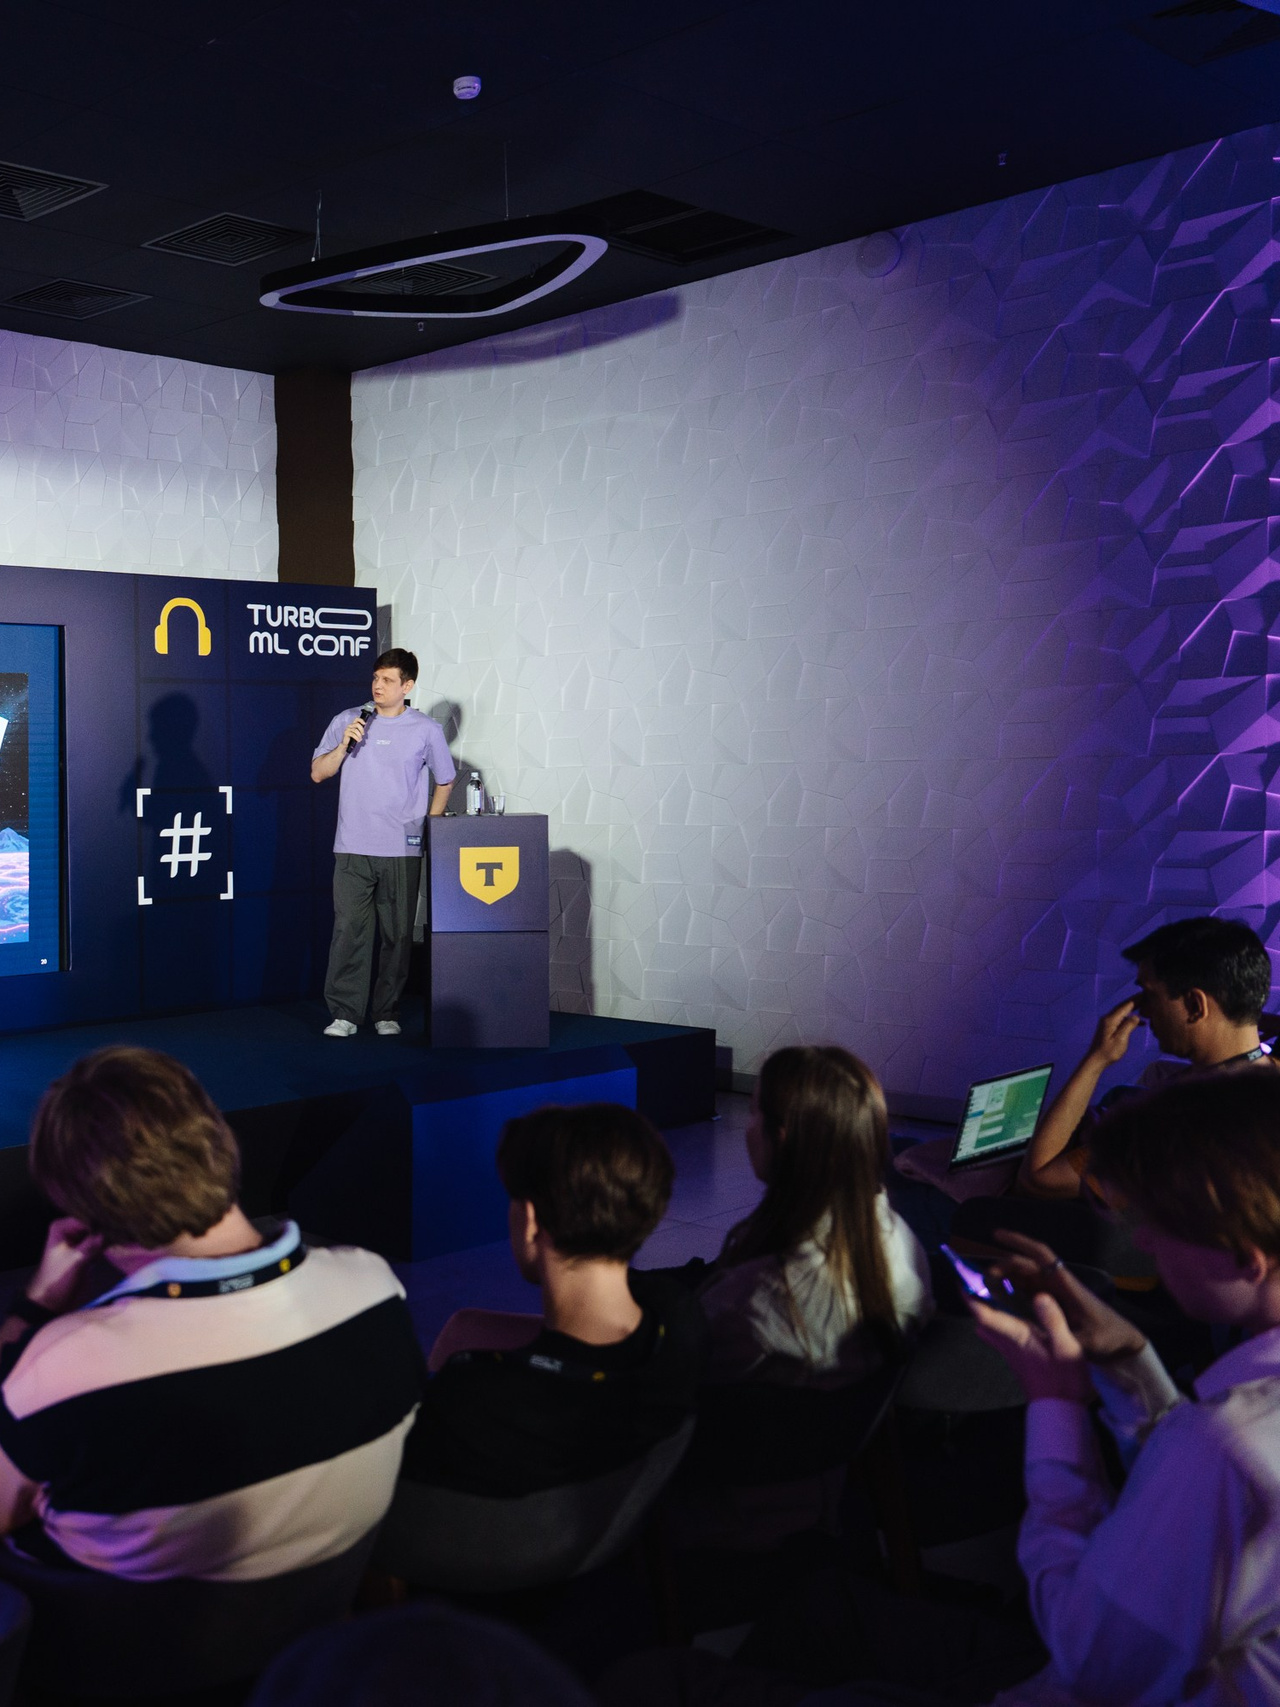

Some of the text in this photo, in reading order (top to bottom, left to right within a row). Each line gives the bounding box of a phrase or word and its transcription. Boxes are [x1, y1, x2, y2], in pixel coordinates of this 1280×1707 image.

[246, 603, 372, 631] TURBO
[249, 631, 371, 657] ML CONF
[475, 861, 504, 887] T
